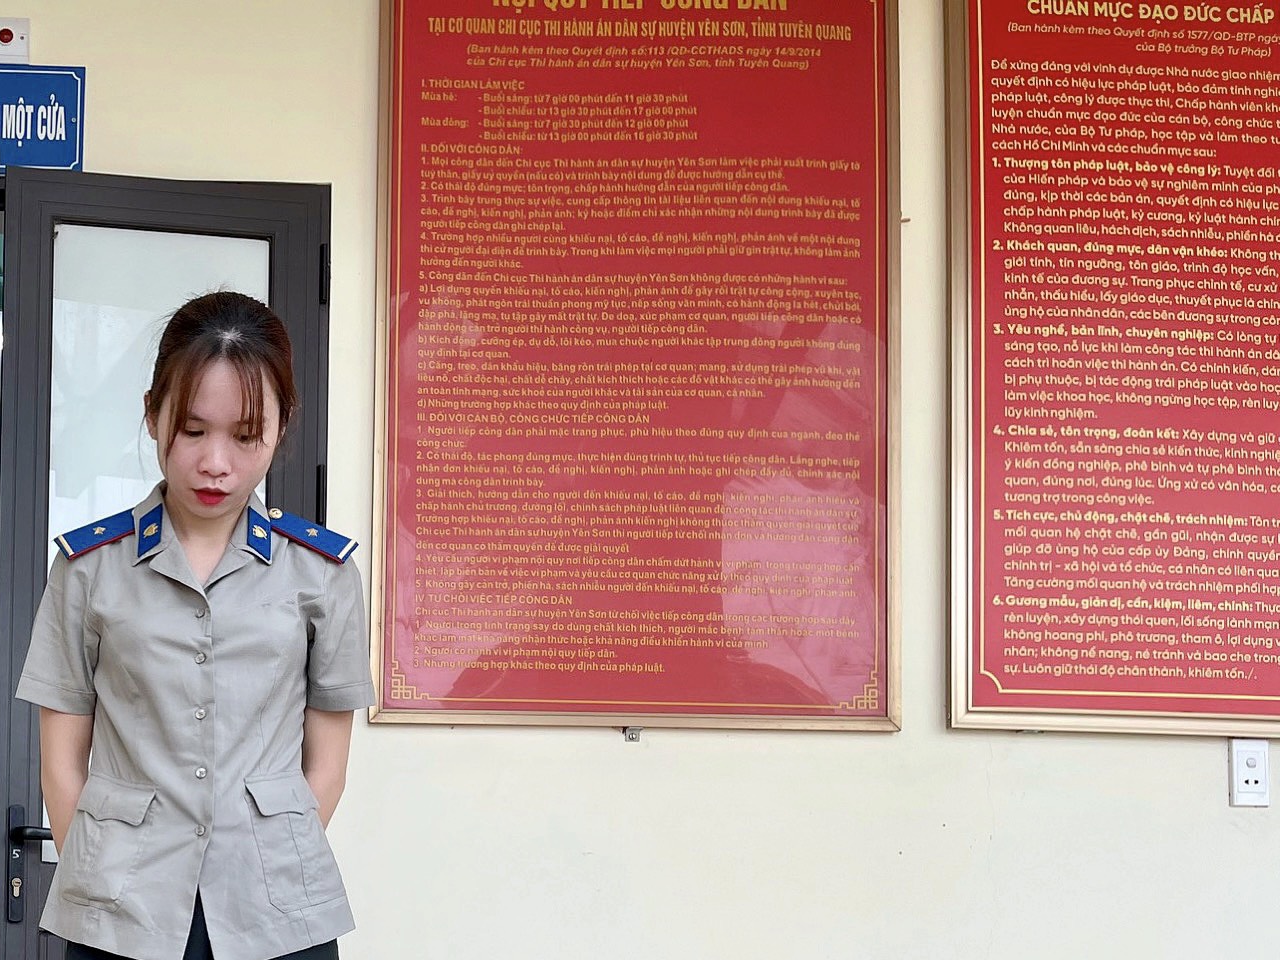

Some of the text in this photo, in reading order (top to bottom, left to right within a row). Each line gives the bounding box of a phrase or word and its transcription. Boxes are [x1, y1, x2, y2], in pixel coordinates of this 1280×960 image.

[1093, 1, 1133, 21] MỰC
[1138, 3, 1178, 23] ĐẠO
[1183, 2, 1221, 22] ĐỨC
[1225, 3, 1274, 24] CHẤP
[427, 17, 445, 36] TẠI
[448, 17, 463, 33] CƠ
[465, 17, 495, 35] QUAN
[498, 18, 516, 35] CHI
[519, 19, 540, 39] CỤC
[543, 20, 560, 36] THI
[640, 20, 656, 40] SỰ
[658, 18, 694, 40] HUYỆN
[698, 18, 719, 37] YÊN
[815, 24, 851, 41] QUANG
[1007, 21, 1031, 32] (Ban
[1087, 25, 1111, 35] theo
[1112, 26, 1145, 38] Quyết
[1146, 28, 1170, 39] định
[1171, 29, 1184, 38] số
[546, 46, 568, 55] theo
[1227, 45, 1239, 55] Tư
[1092, 63, 1116, 73] vinh
[1117, 63, 1133, 76] dự
[1135, 65, 1164, 77] được
[1220, 69, 1247, 80] giao
[2, 97, 34, 147] MỘT
[37, 94, 66, 141] CỬA
[991, 156, 1001, 167] 1.
[1003, 157, 1048, 170] Thượng
[1050, 158, 1071, 168] tôn
[1073, 159, 1104, 171] pháp
[1135, 160, 1158, 172] bảo
[1159, 162, 1174, 175] vệ
[1176, 163, 1205, 176] công
[1222, 165, 1254, 178] Tuyệt
[992, 239, 1003, 250] 2.
[1006, 239, 1044, 250] Khách
[1046, 242, 1081, 253] quan,
[1146, 243, 1169, 254] dân
[1171, 245, 1194, 258] vận
[1230, 247, 1266, 262] Không
[993, 424, 1004, 435] 4.
[1007, 424, 1036, 435] Chia
[1060, 425, 1080, 436] tôn
[1083, 427, 1120, 439] trọng,
[1022, 662, 1051, 673] Luôn
[1098, 664, 1115, 677] độ
[1116, 665, 1146, 676] chân
[1188, 666, 1223, 677] khiêm
